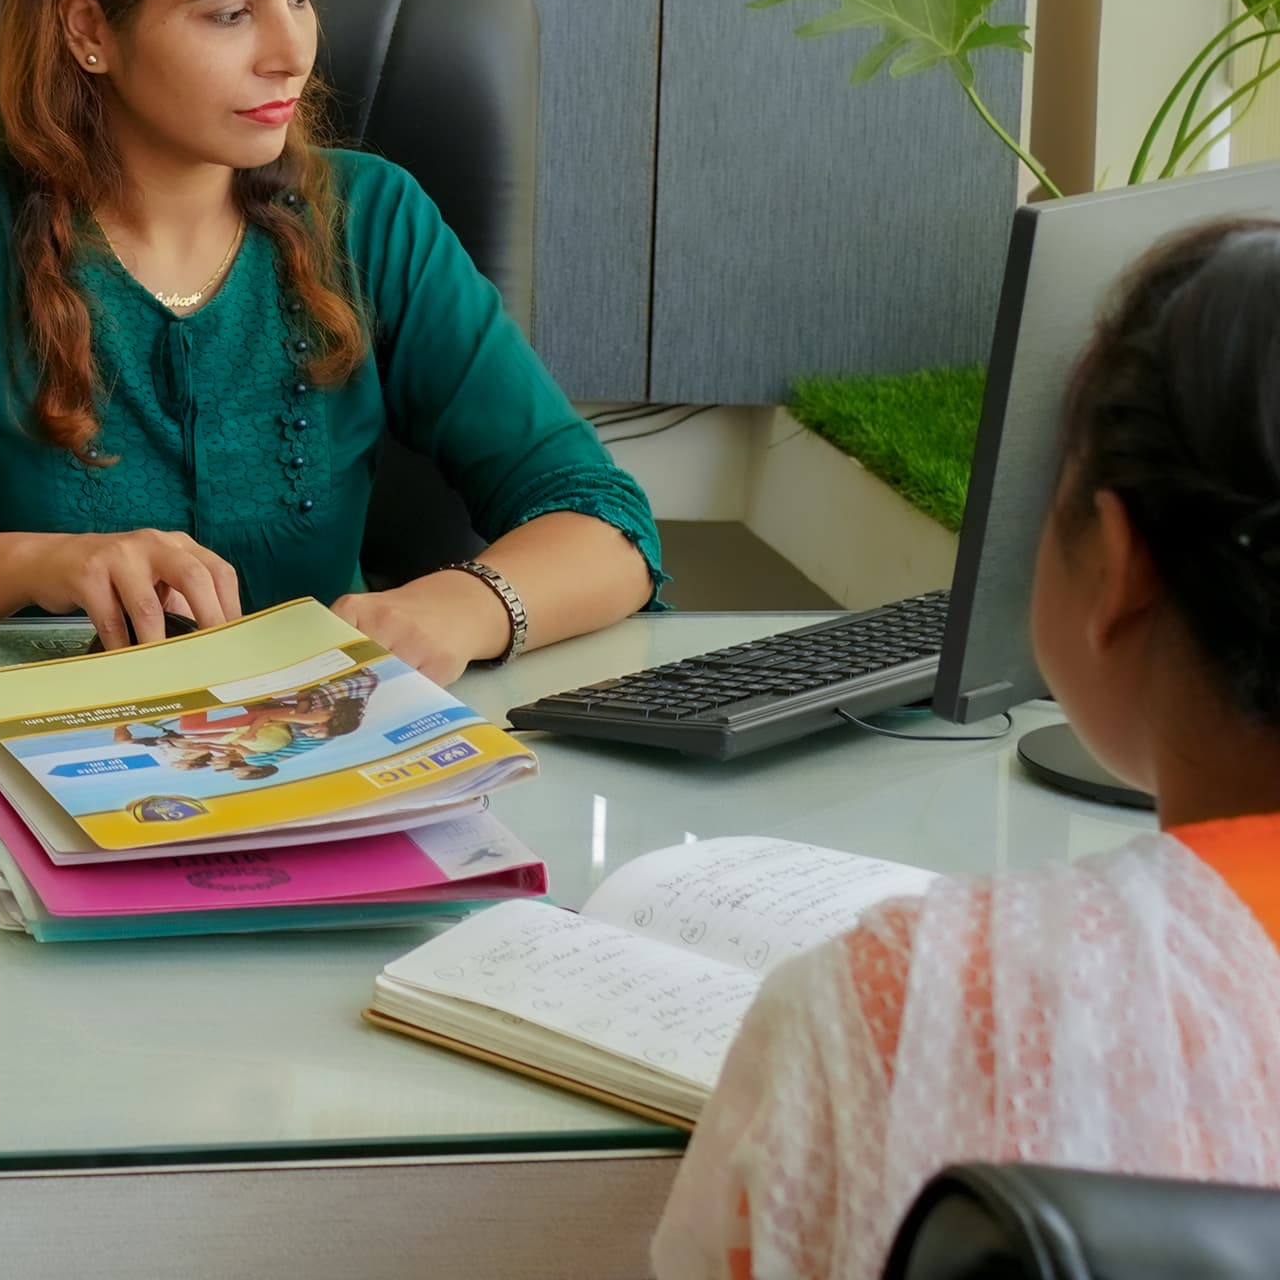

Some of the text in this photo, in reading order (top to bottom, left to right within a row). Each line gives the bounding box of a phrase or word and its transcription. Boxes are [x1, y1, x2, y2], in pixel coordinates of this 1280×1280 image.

[396, 717, 451, 741] Premium
[76, 763, 129, 775] Benefits
[377, 760, 433, 783] LIC
